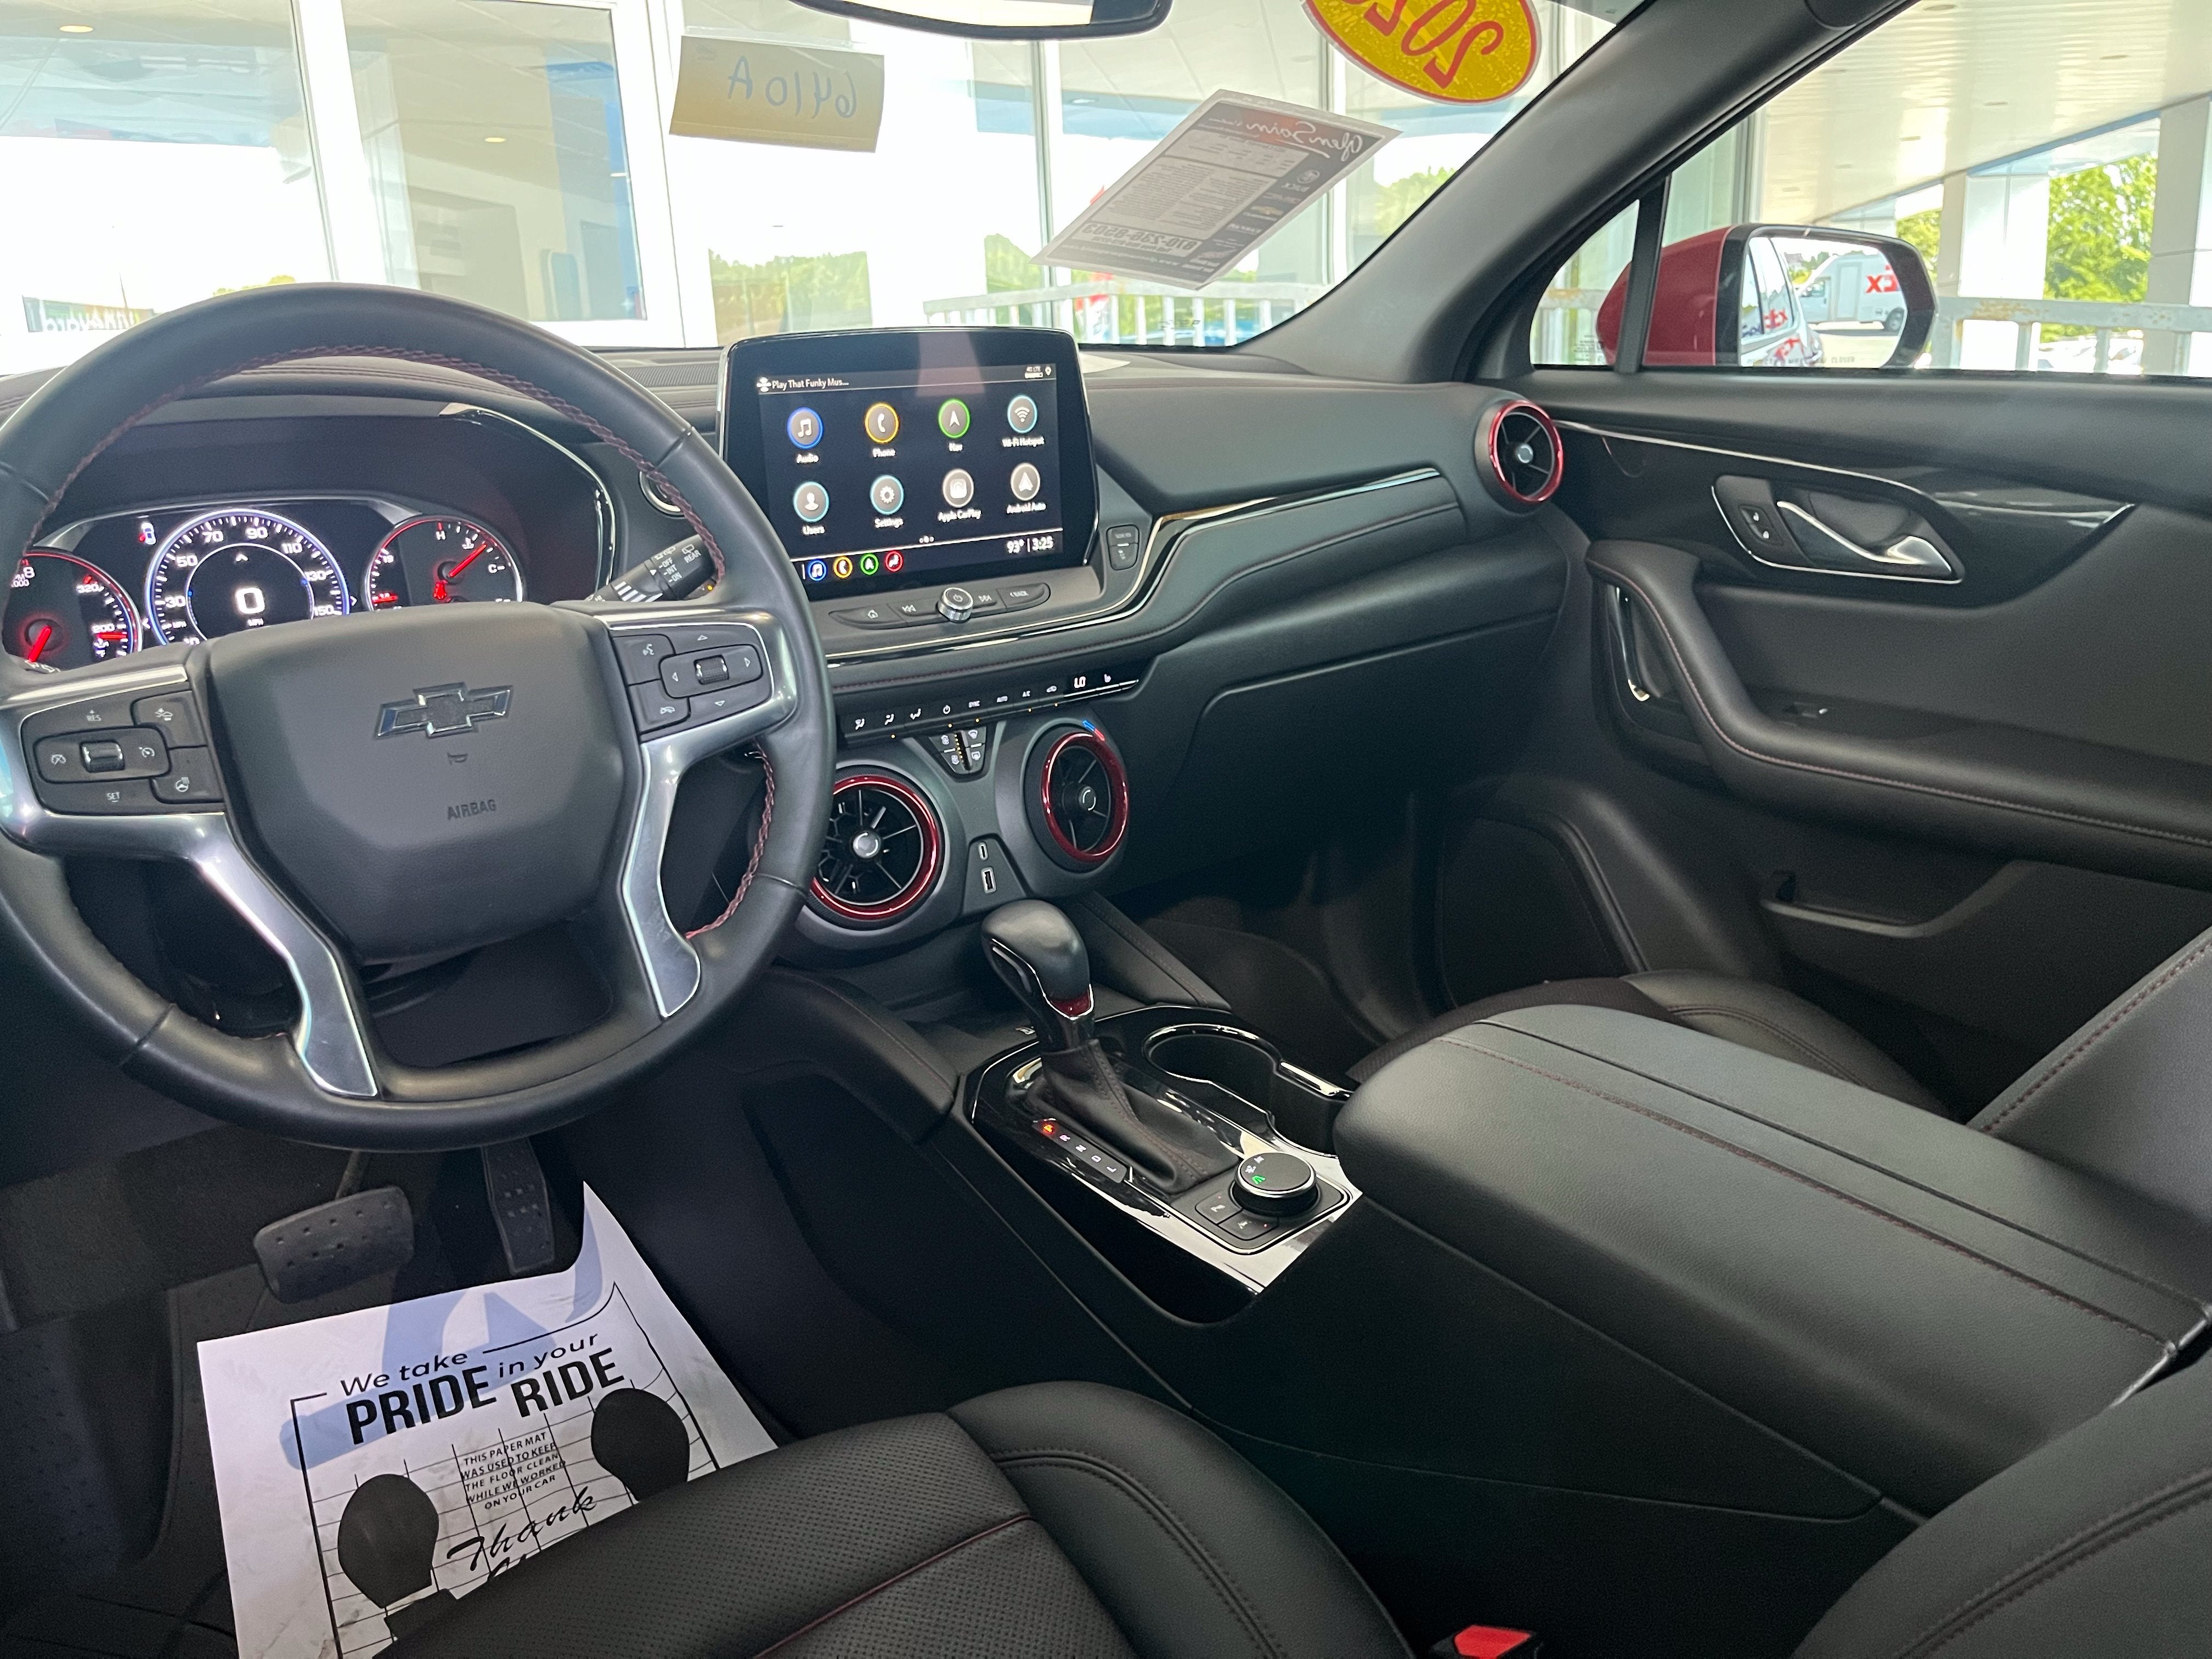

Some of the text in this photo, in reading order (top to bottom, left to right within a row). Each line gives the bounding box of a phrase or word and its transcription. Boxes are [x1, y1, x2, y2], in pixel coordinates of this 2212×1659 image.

[772, 380, 787, 391] Play
[788, 379, 805, 388] That
[805, 378, 827, 390] Funky
[872, 447, 896, 458] Phone
[949, 442, 963, 452] Nav
[797, 453, 820, 464] Audio
[874, 517, 904, 528] Settings
[246, 527, 269, 539] 90
[436, 531, 446, 540] H
[803, 525, 825, 535] Users
[203, 531, 224, 543] 70
[281, 543, 303, 554] 110
[176, 555, 199, 567] 50
[684, 549, 702, 564] REAR
[23, 566, 36, 579] 8
[304, 570, 328, 582] 130
[77, 583, 100, 594] 320
[165, 595, 187, 608] 30
[235, 587, 266, 614] 0
[314, 605, 335, 617] 150
[92, 622, 115, 633] 200
[447, 799, 497, 821] AIRBAG
[1075, 1144, 1087, 1153] N
[498, 1333, 599, 1379] in your
[340, 1352, 469, 1397] We take
[510, 1347, 625, 1418] RIDE
[346, 1365, 496, 1446] PRIDE
[464, 1432, 546, 1466] THIS PAPER MAT
[461, 1442, 557, 1480] WAS USED TO KEEP
[465, 1453, 558, 1492] THE FLOOR CLEAN
[467, 1459, 566, 1503] WHILE WE WORKED
[484, 1475, 556, 1510] ON YOUR CAR
[446, 1485, 597, 1572] Thank
